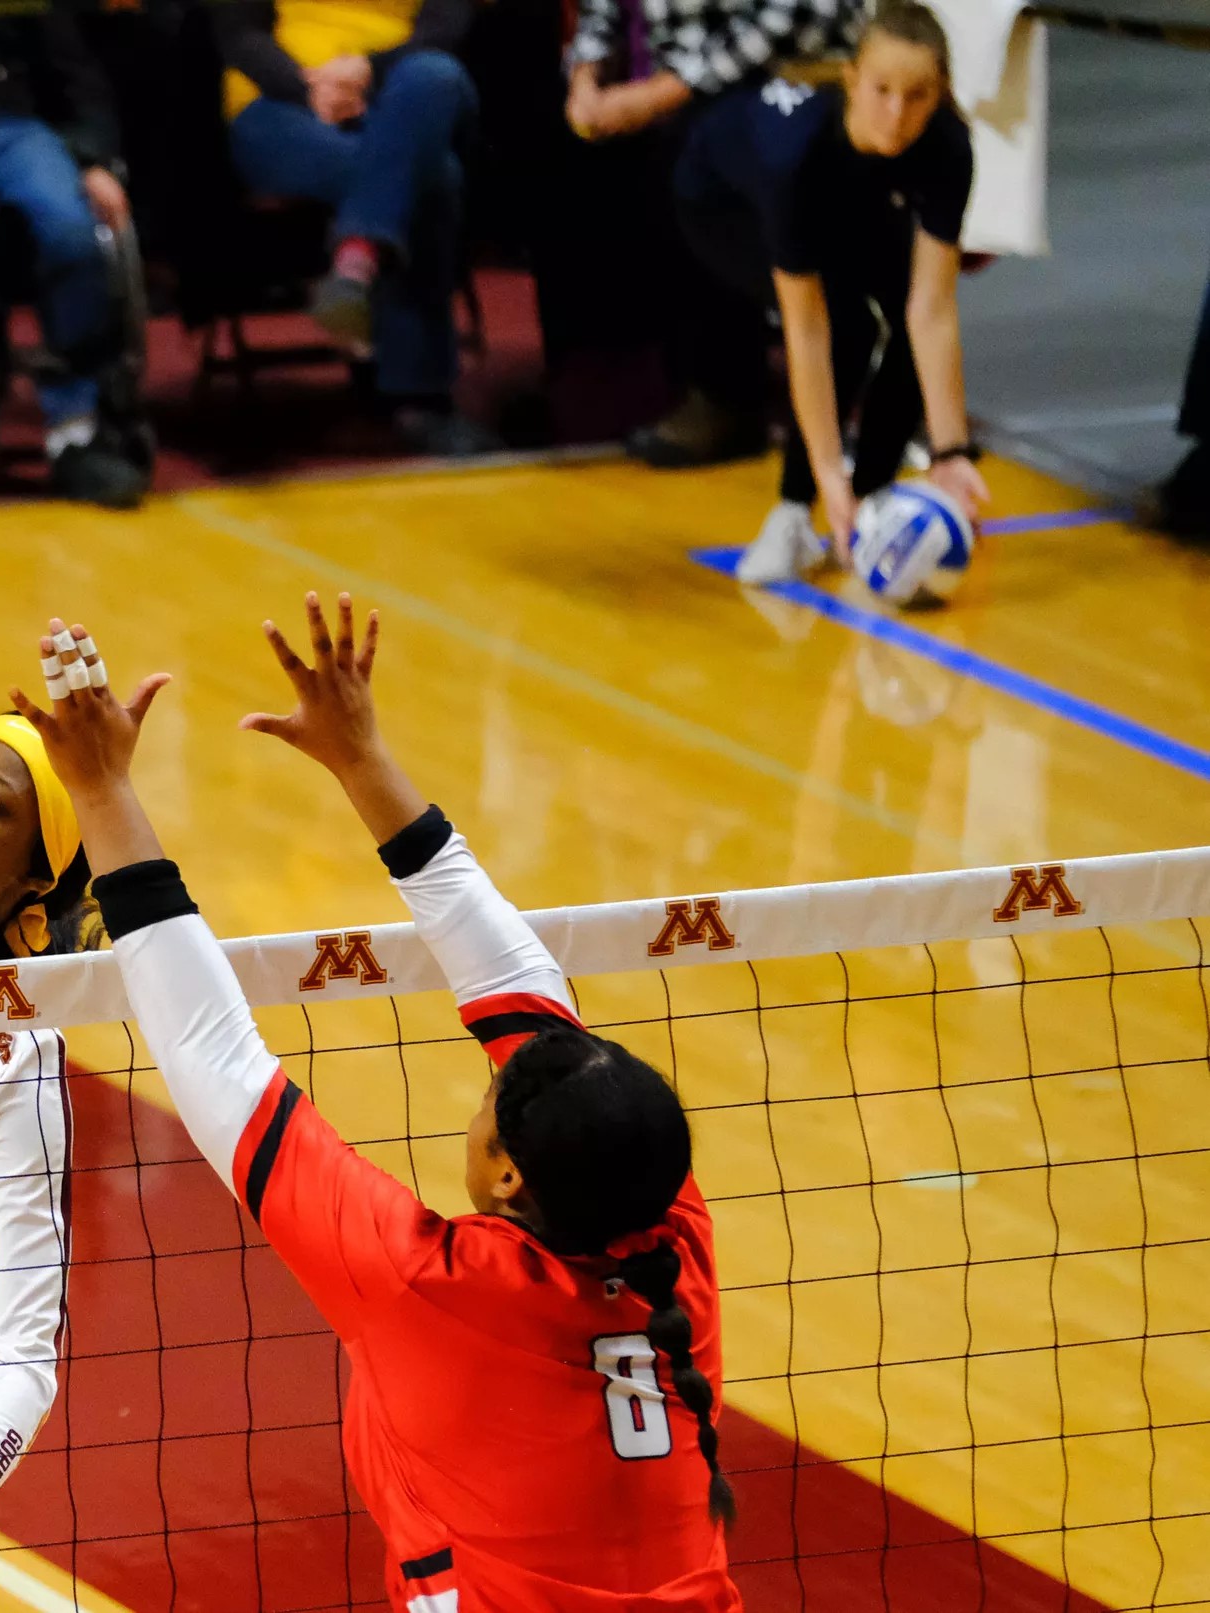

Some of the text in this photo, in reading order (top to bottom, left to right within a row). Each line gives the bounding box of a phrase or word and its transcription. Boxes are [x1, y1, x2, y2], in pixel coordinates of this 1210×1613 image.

[993, 864, 1080, 922] M
[648, 897, 735, 956] M
[299, 931, 387, 991] M
[589, 1331, 673, 1461] 8
